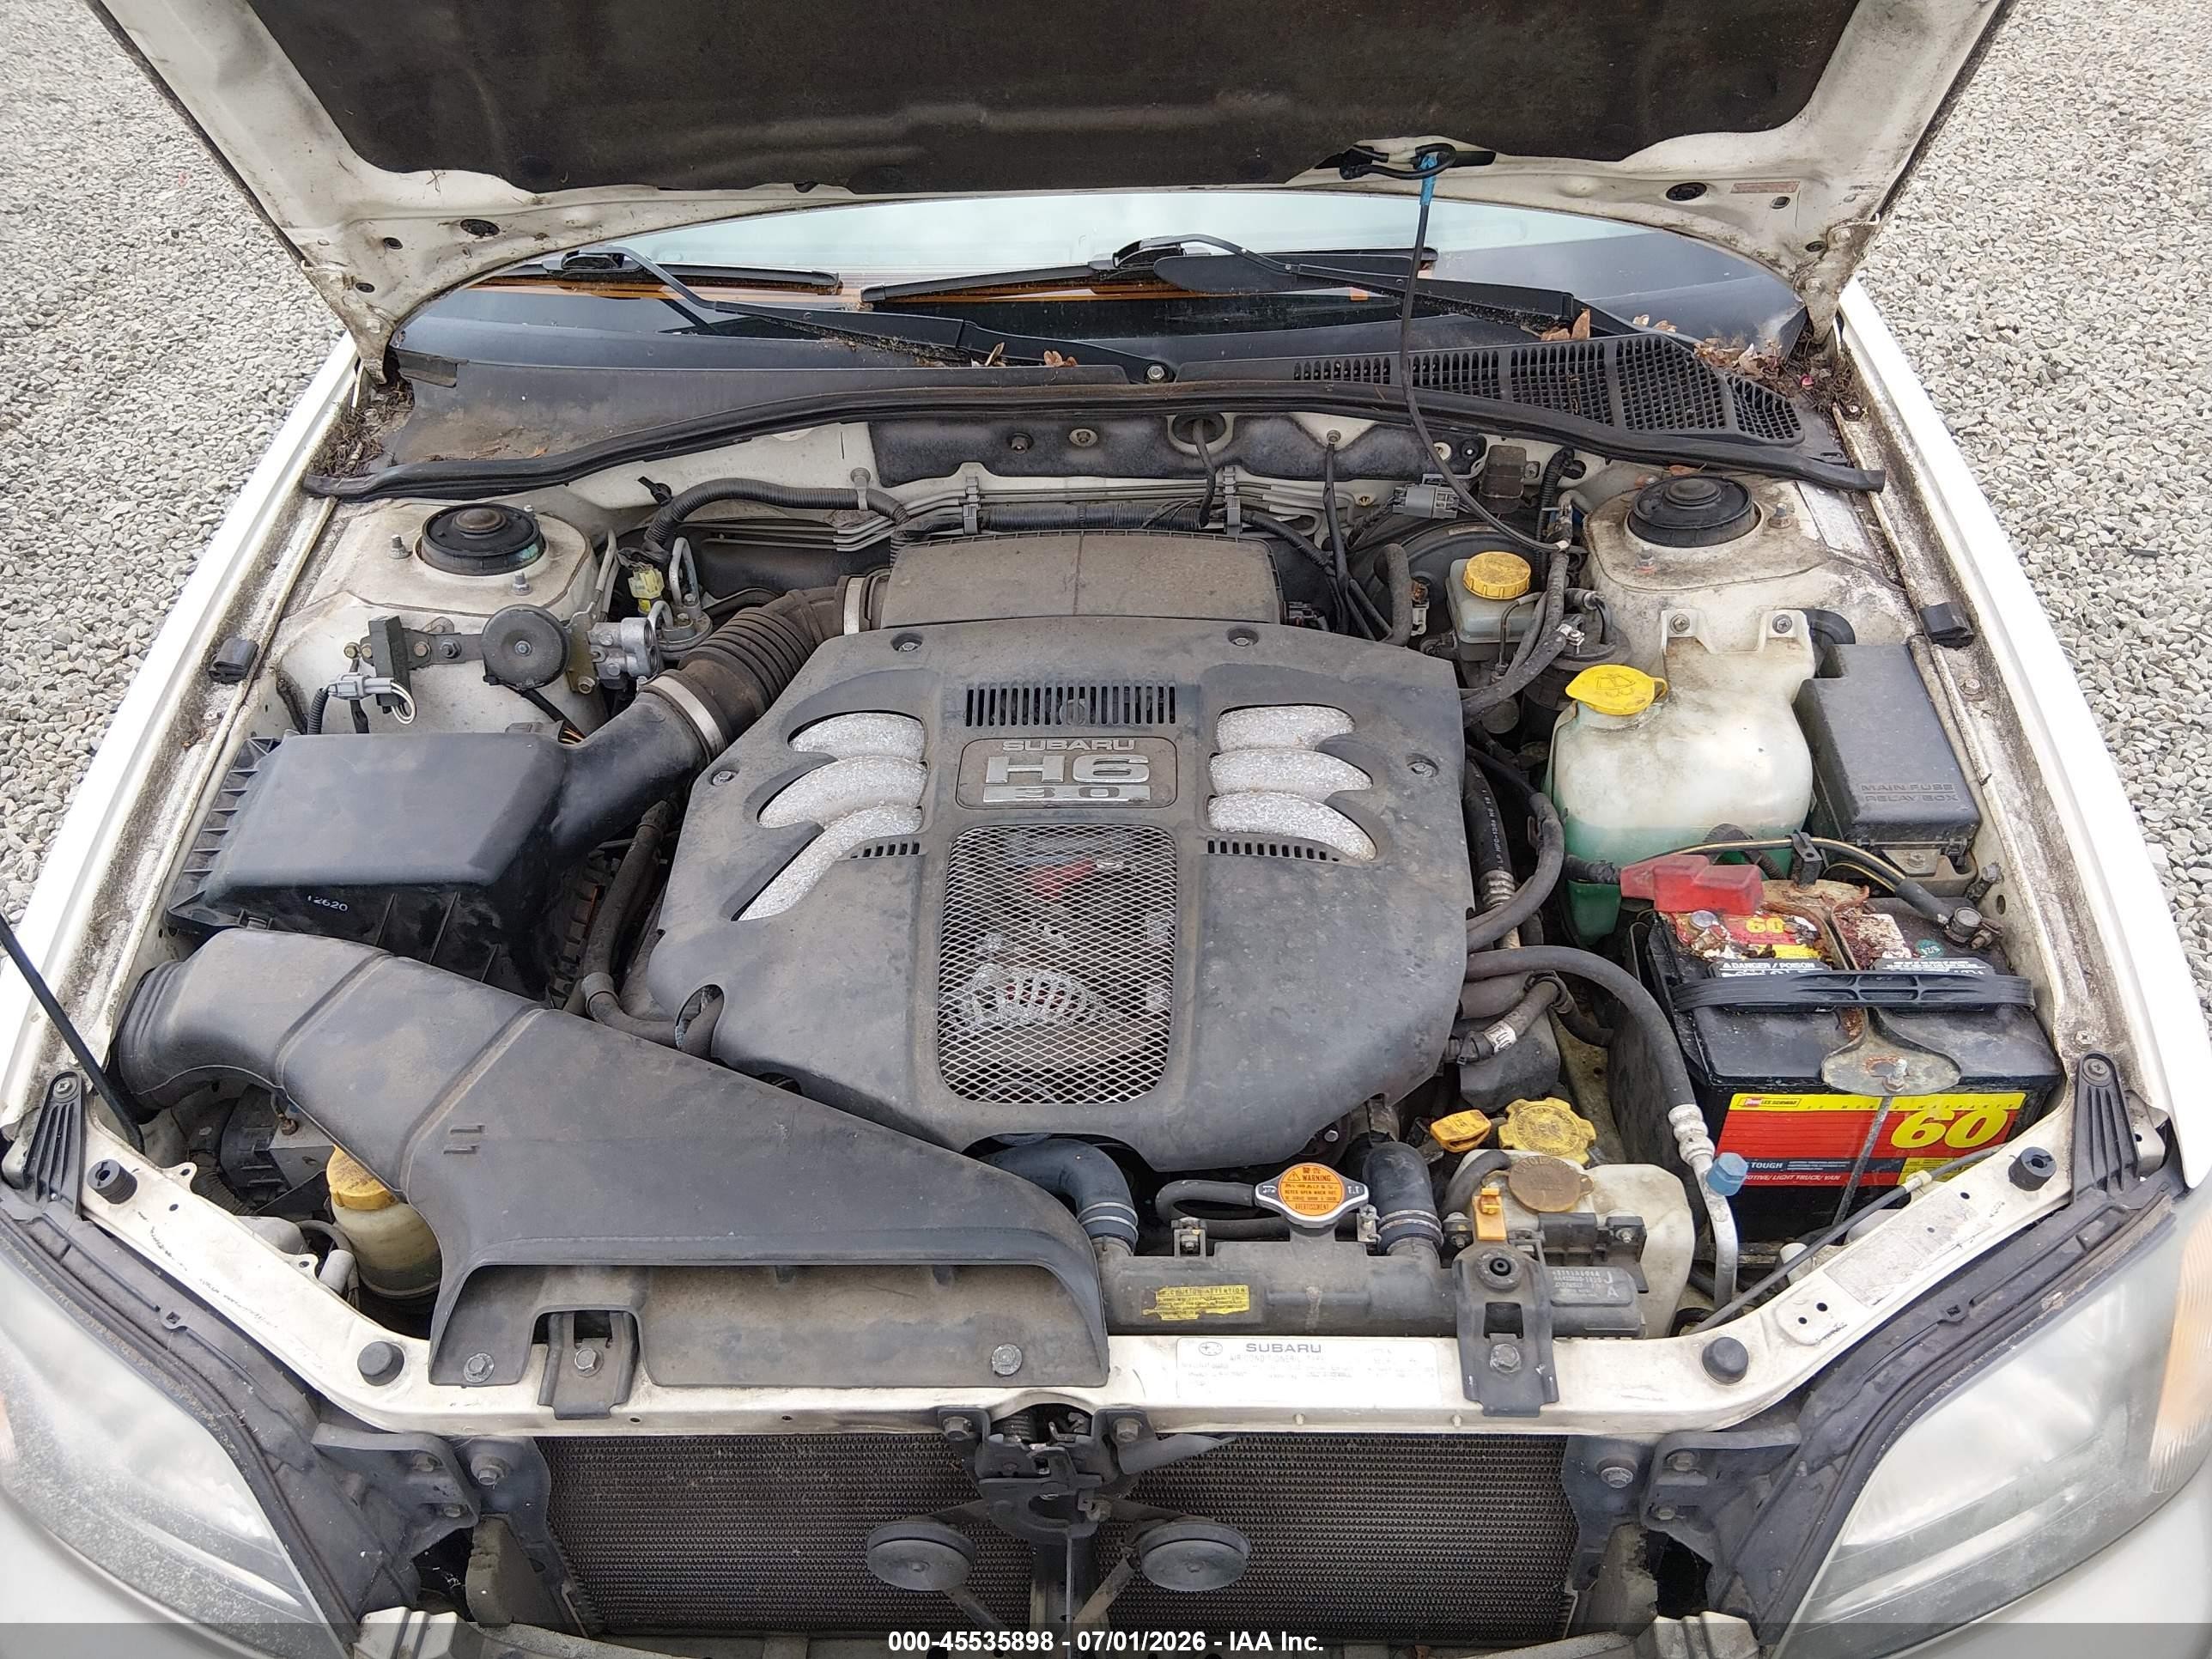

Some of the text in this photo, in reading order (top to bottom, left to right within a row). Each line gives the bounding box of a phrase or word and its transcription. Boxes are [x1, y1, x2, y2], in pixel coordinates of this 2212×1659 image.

[1002, 739, 1135, 751] SUBARU
[985, 754, 1151, 784] H6
[1891, 1106, 2008, 1149] 60
[1245, 1343, 1322, 1354] SUBARU
